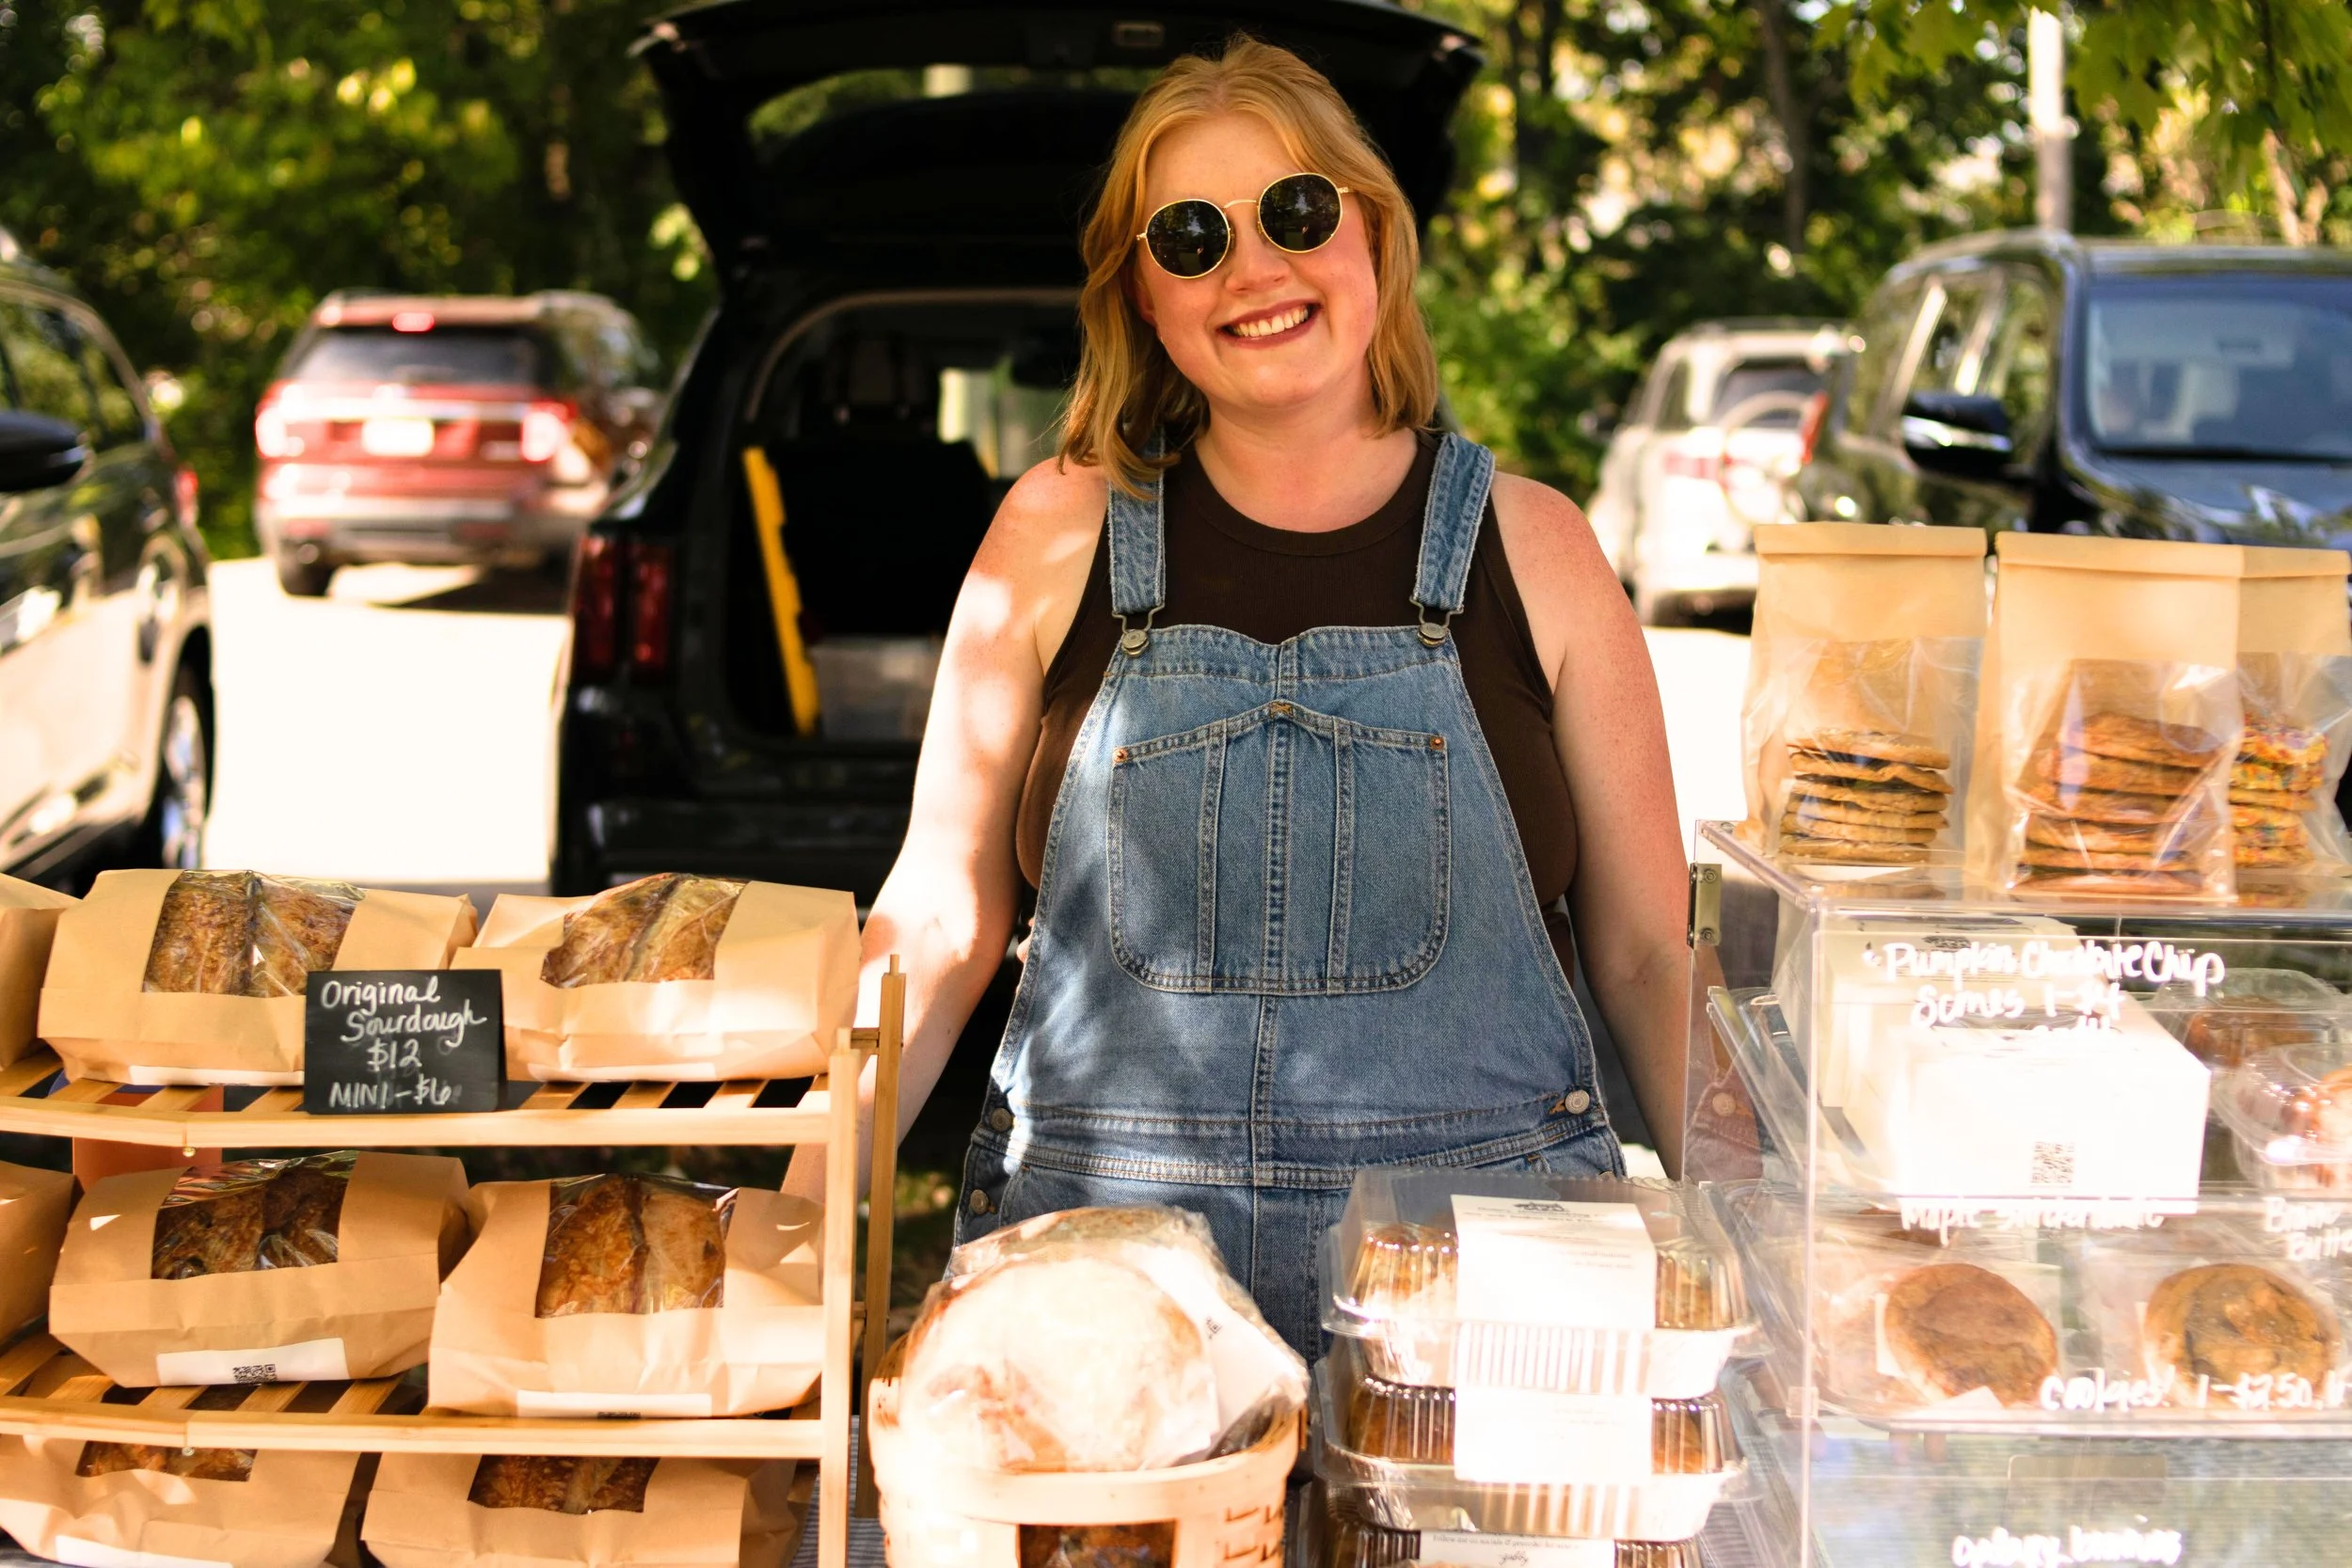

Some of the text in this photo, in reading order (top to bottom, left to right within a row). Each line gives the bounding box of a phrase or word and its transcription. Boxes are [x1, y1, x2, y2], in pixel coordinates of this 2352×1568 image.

[1883, 941, 2016, 990] Pumpkin
[2143, 941, 2225, 997] Chip
[321, 975, 440, 1016] Original
[340, 998, 487, 1047] Sourdough
[366, 1037, 422, 1071] $12
